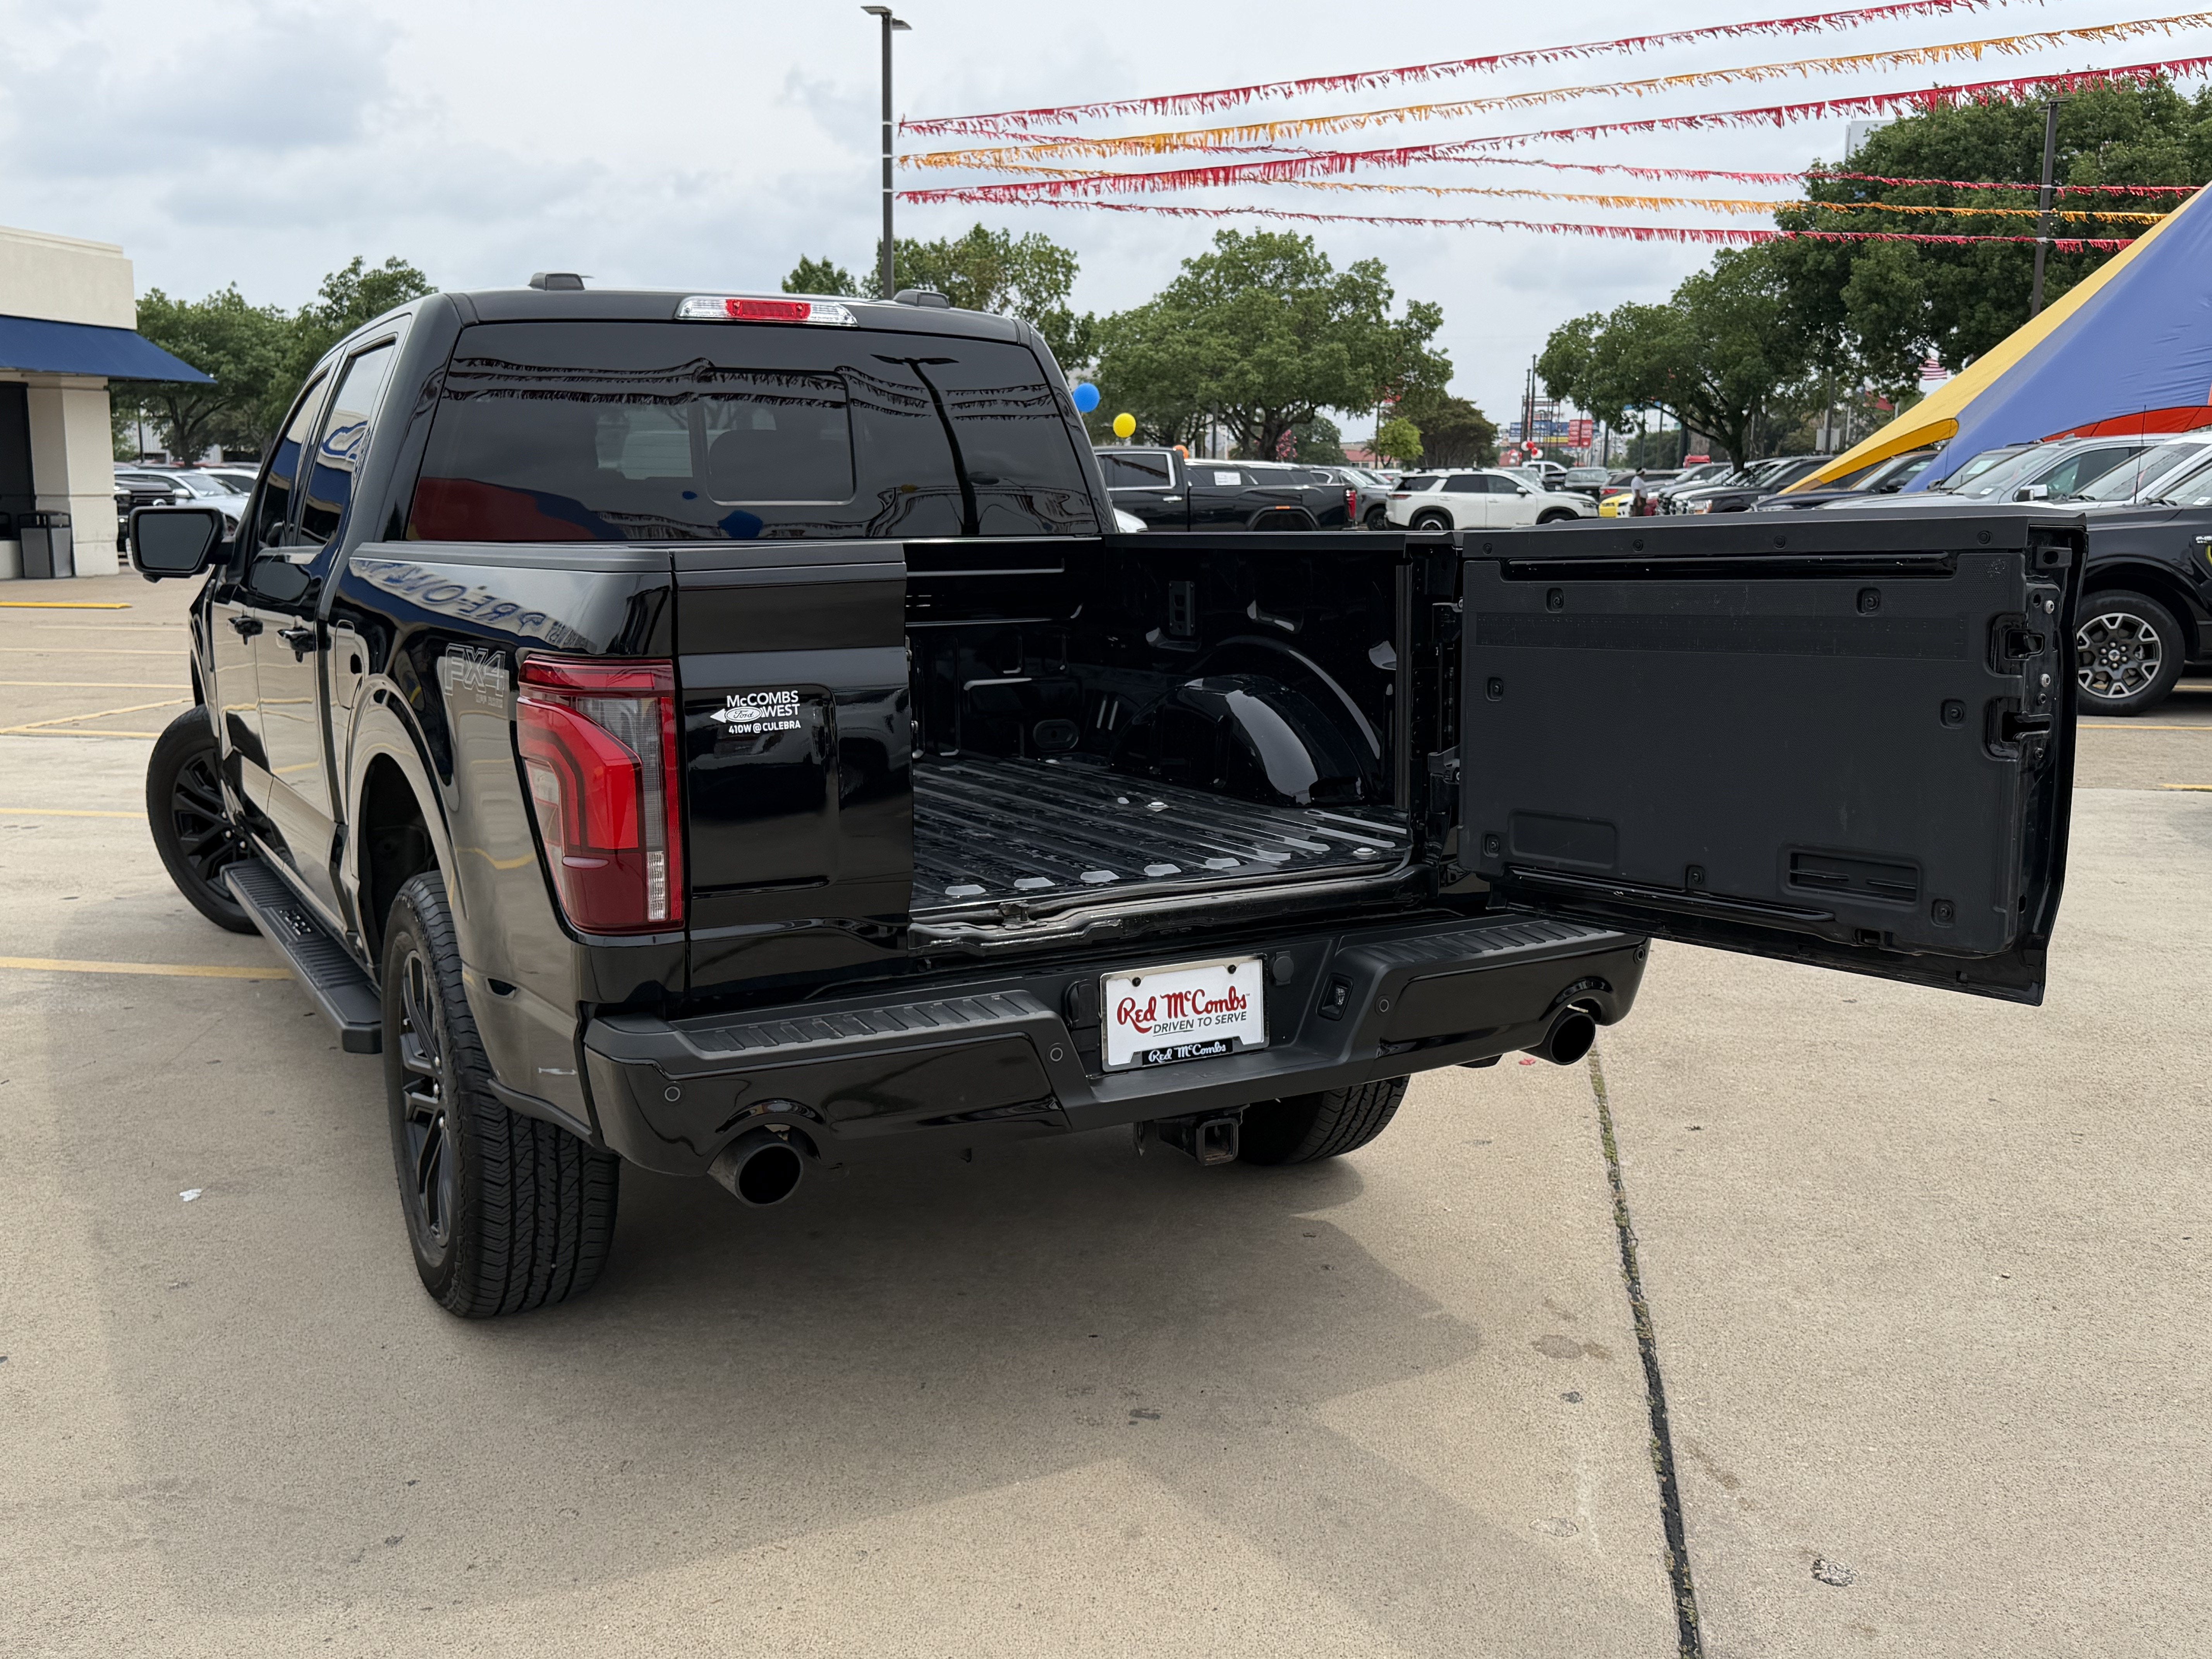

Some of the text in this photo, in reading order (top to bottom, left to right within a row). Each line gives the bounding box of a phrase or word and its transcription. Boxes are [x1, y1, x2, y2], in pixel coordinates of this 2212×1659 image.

[445, 643, 506, 697] FX4
[726, 690, 799, 707] McCOMBS
[733, 710, 754, 718] Ford
[763, 704, 800, 717] WEST
[1117, 986, 1247, 1034] Red McCombs
[1153, 1011, 1247, 1034] DRIVEN TO SERVE
[1148, 1050, 1172, 1063] Red
